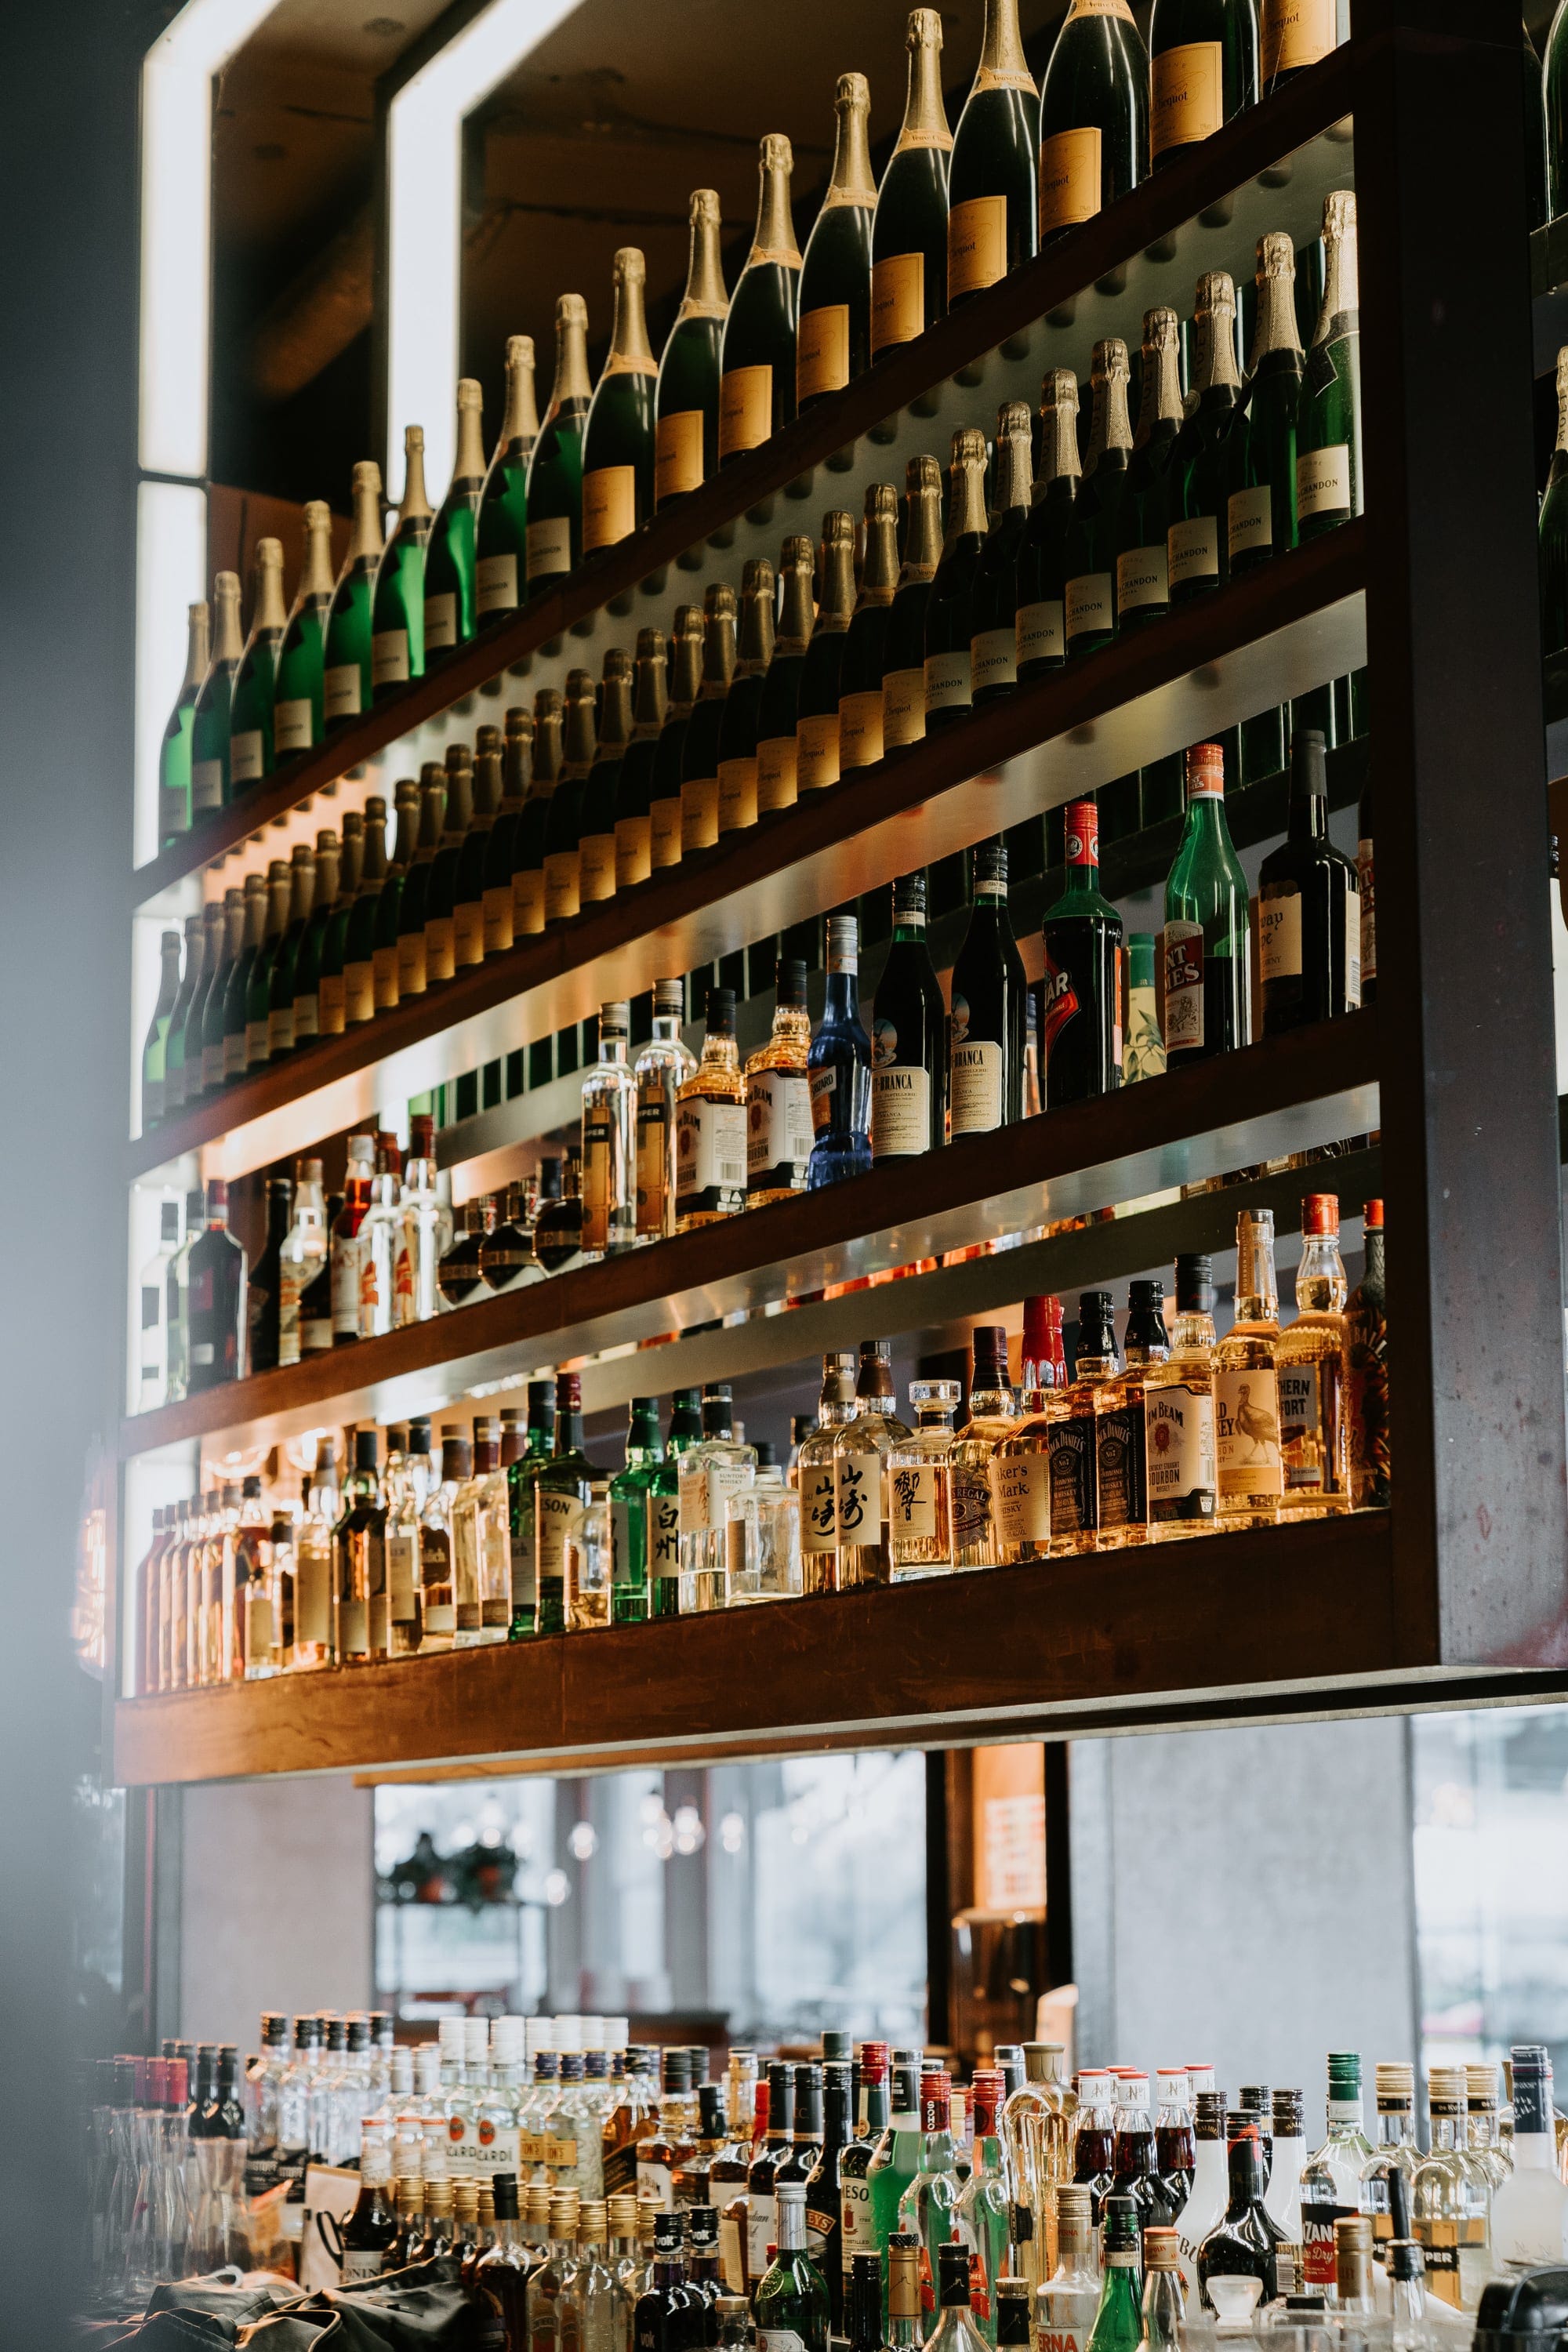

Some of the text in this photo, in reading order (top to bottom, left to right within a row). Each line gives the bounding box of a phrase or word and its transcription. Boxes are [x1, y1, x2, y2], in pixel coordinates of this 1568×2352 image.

[1167, 962, 1200, 991] ES
[1158, 1401, 1185, 1428] BEAM
[957, 1487, 986, 1501] REGAL
[927, 2100, 935, 2131] SOHO
[1304, 2220, 1333, 2245] ZAN
